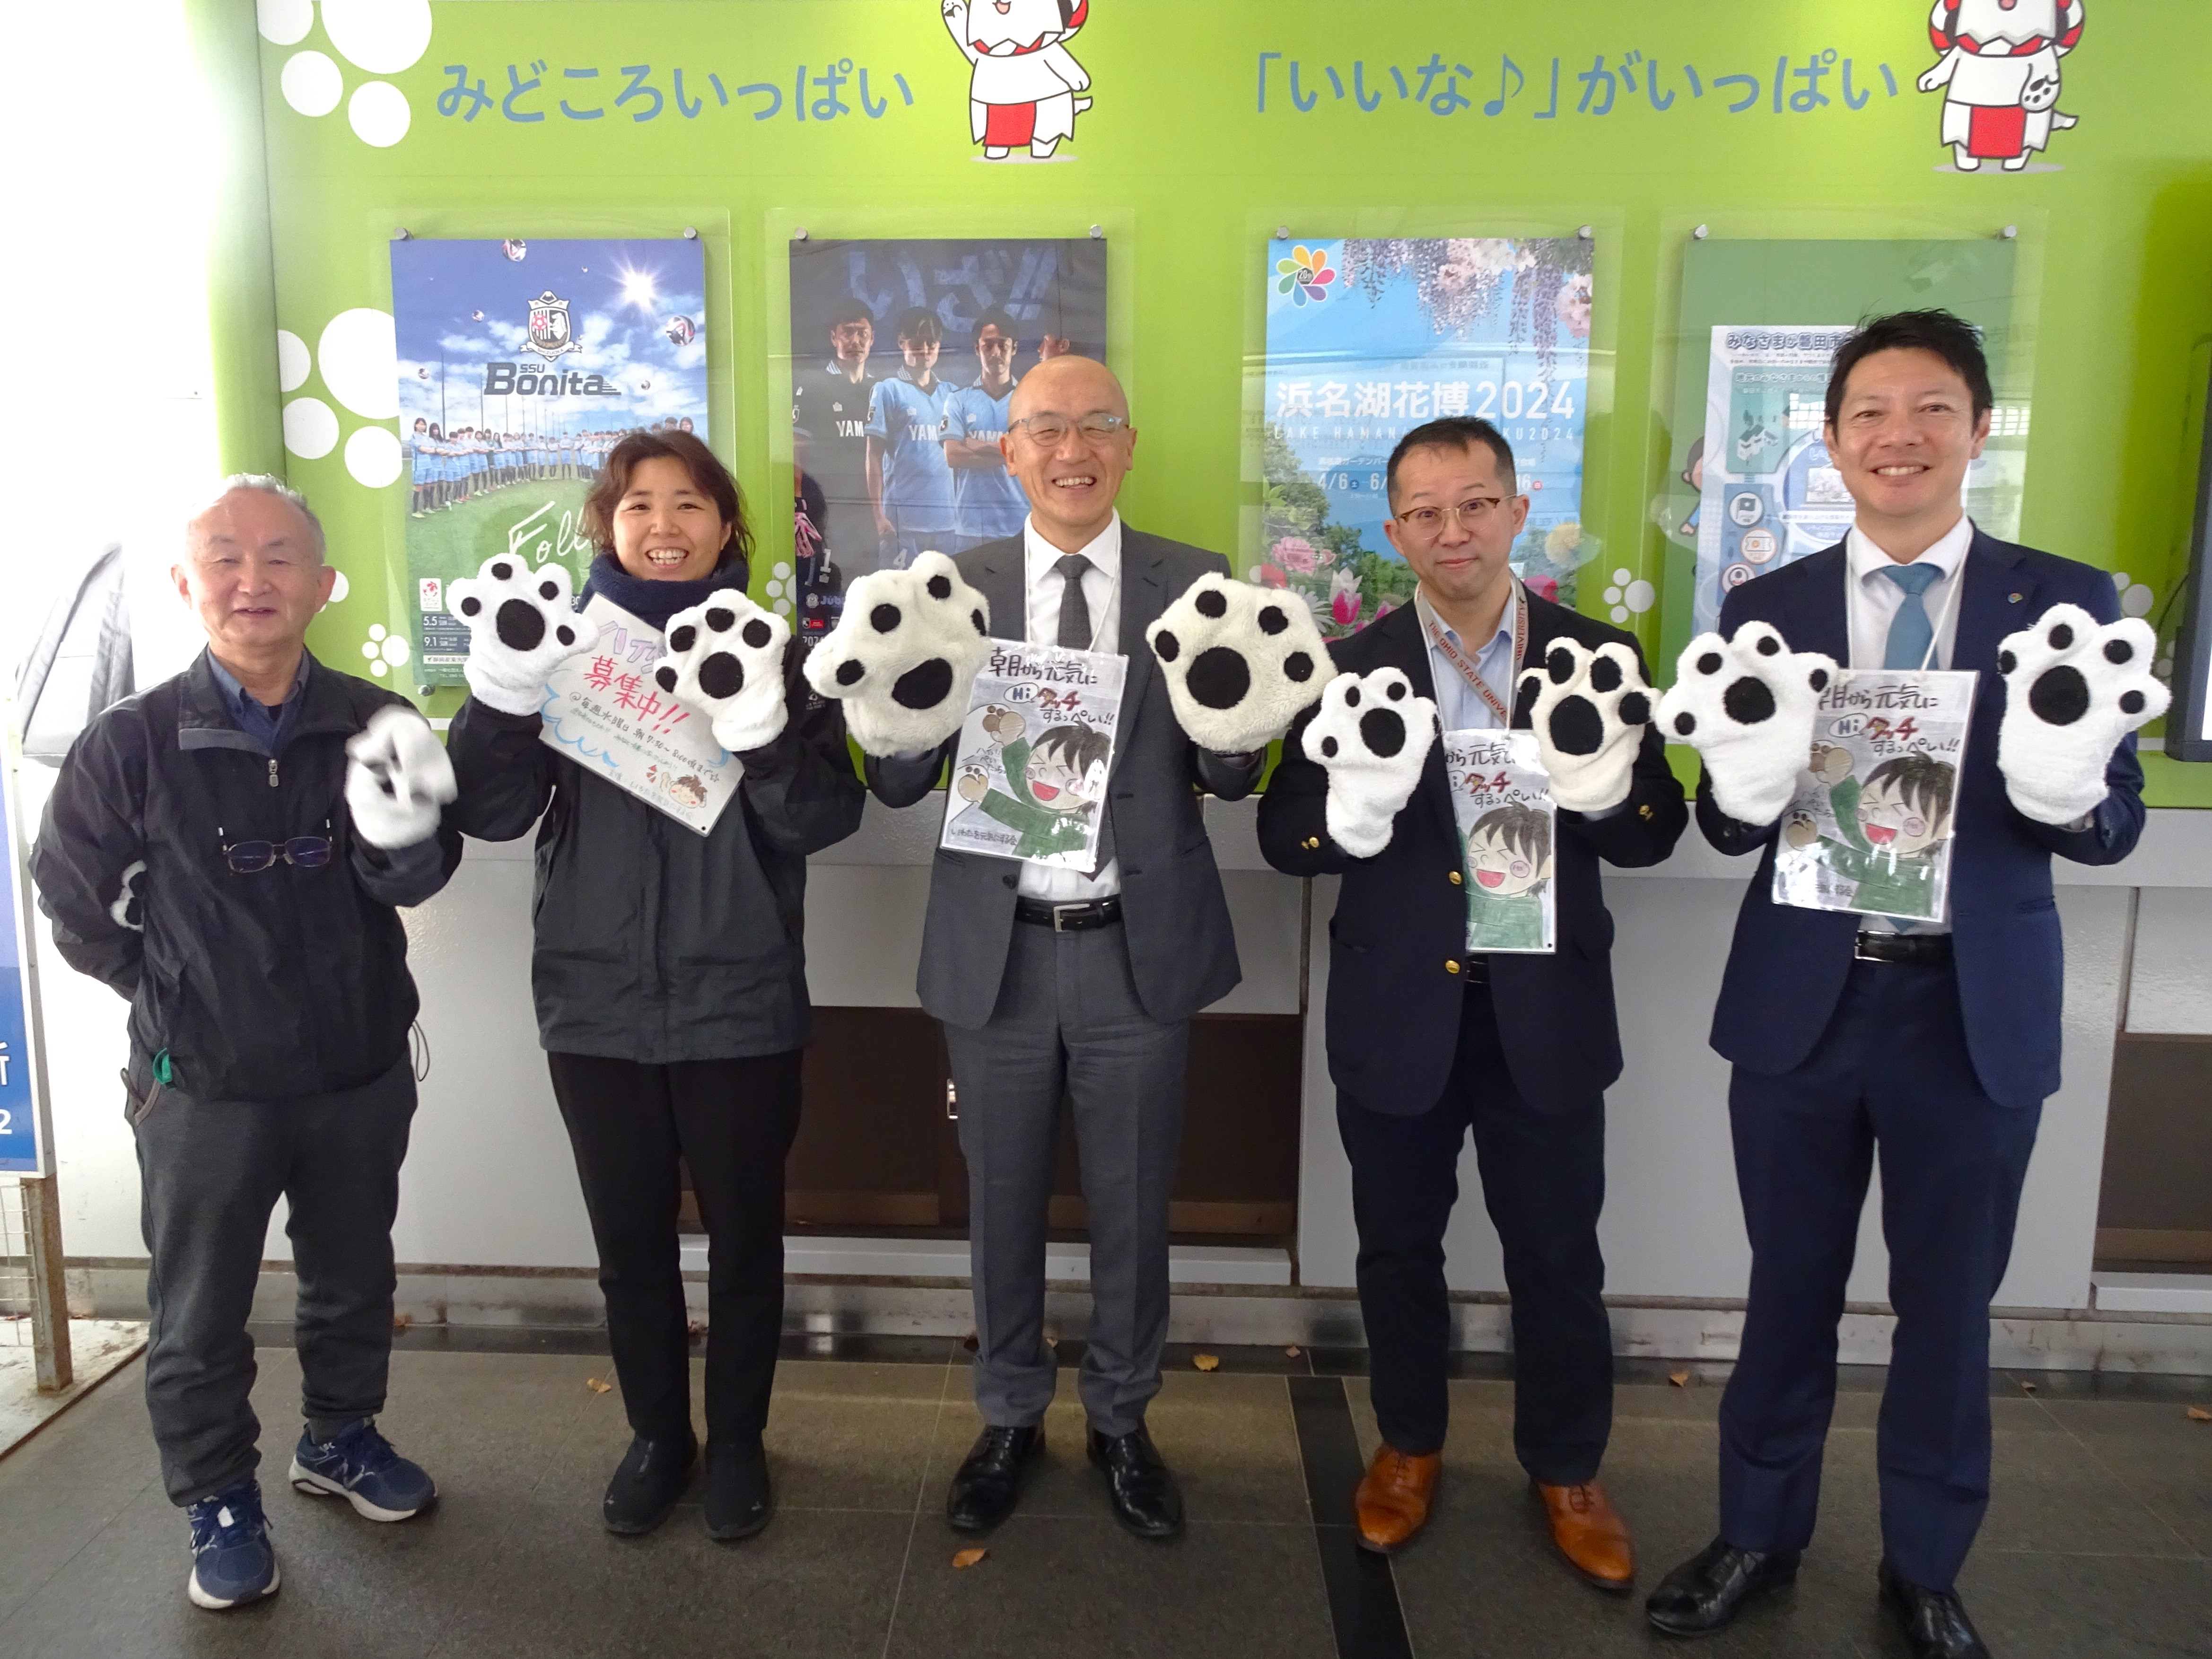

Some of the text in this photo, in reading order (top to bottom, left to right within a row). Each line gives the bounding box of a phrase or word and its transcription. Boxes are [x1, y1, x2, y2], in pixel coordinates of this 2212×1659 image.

[437, 58, 915, 122] みどころいっぱい
[483, 362, 610, 395] Bonita
[520, 363, 545, 374] SSU
[1276, 380, 1575, 419] 浜名湖花博2024
[836, 420, 865, 437] YAM
[909, 424, 939, 441] YAM
[1274, 426, 1319, 439] LAKE
[1503, 427, 1574, 441] KU2024
[1318, 472, 1348, 490] 4/6
[508, 500, 589, 563] Foll
[423, 616, 437, 626] 5.5
[424, 636, 437, 646] 9.1
[988, 646, 1098, 685] 朝から元気に
[1428, 621, 1506, 718] THE OHIO STATE UNIVE
[584, 655, 691, 734] 募集中!!
[1013, 687, 1082, 711] Hi タッチ
[1838, 716, 1919, 741] Hi タッチ
[1445, 742, 1516, 767] から元気
[1465, 771, 1511, 795] タッチ
